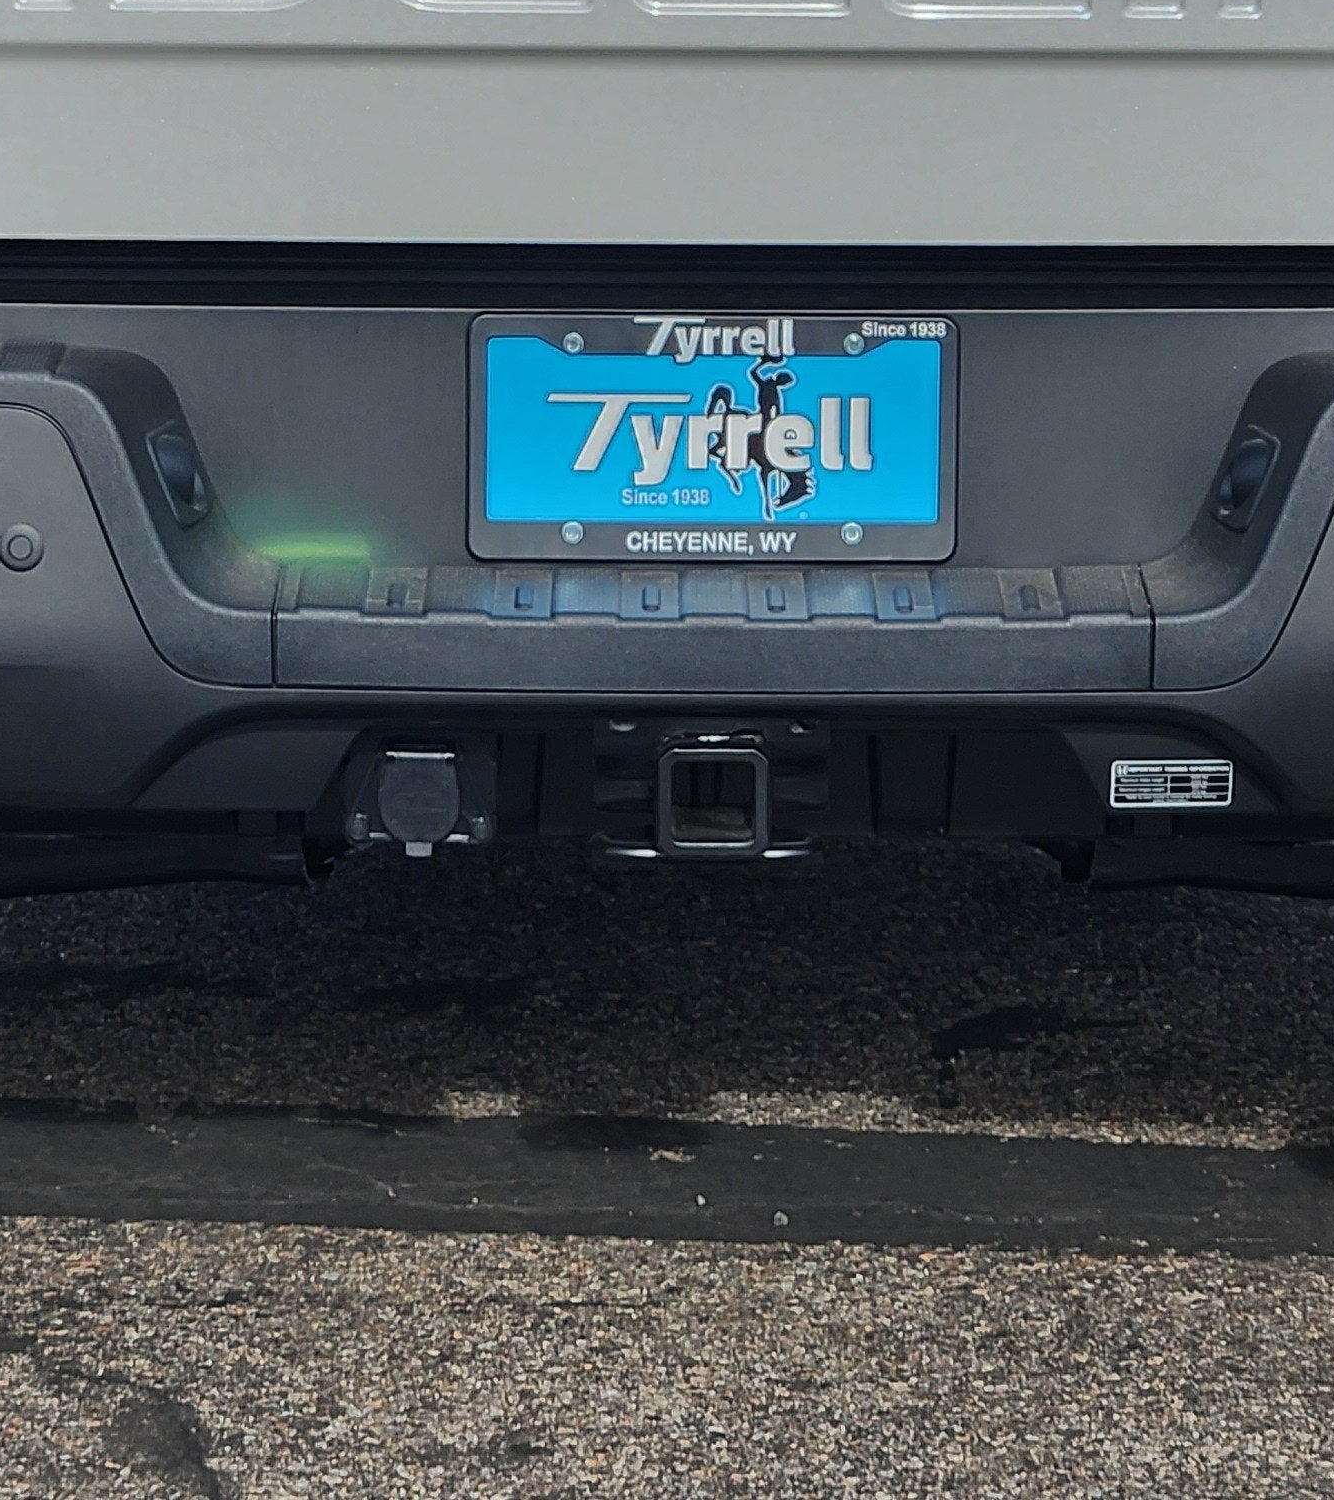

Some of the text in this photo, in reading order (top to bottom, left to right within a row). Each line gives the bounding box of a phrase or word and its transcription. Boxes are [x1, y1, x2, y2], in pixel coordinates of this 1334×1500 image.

[634, 317, 795, 364] Tyrrell
[861, 320, 947, 338] Since 1938
[547, 393, 873, 486] Tyrrell
[621, 488, 710, 505] Since 1938
[626, 530, 798, 556] CHEYENNE, WY
